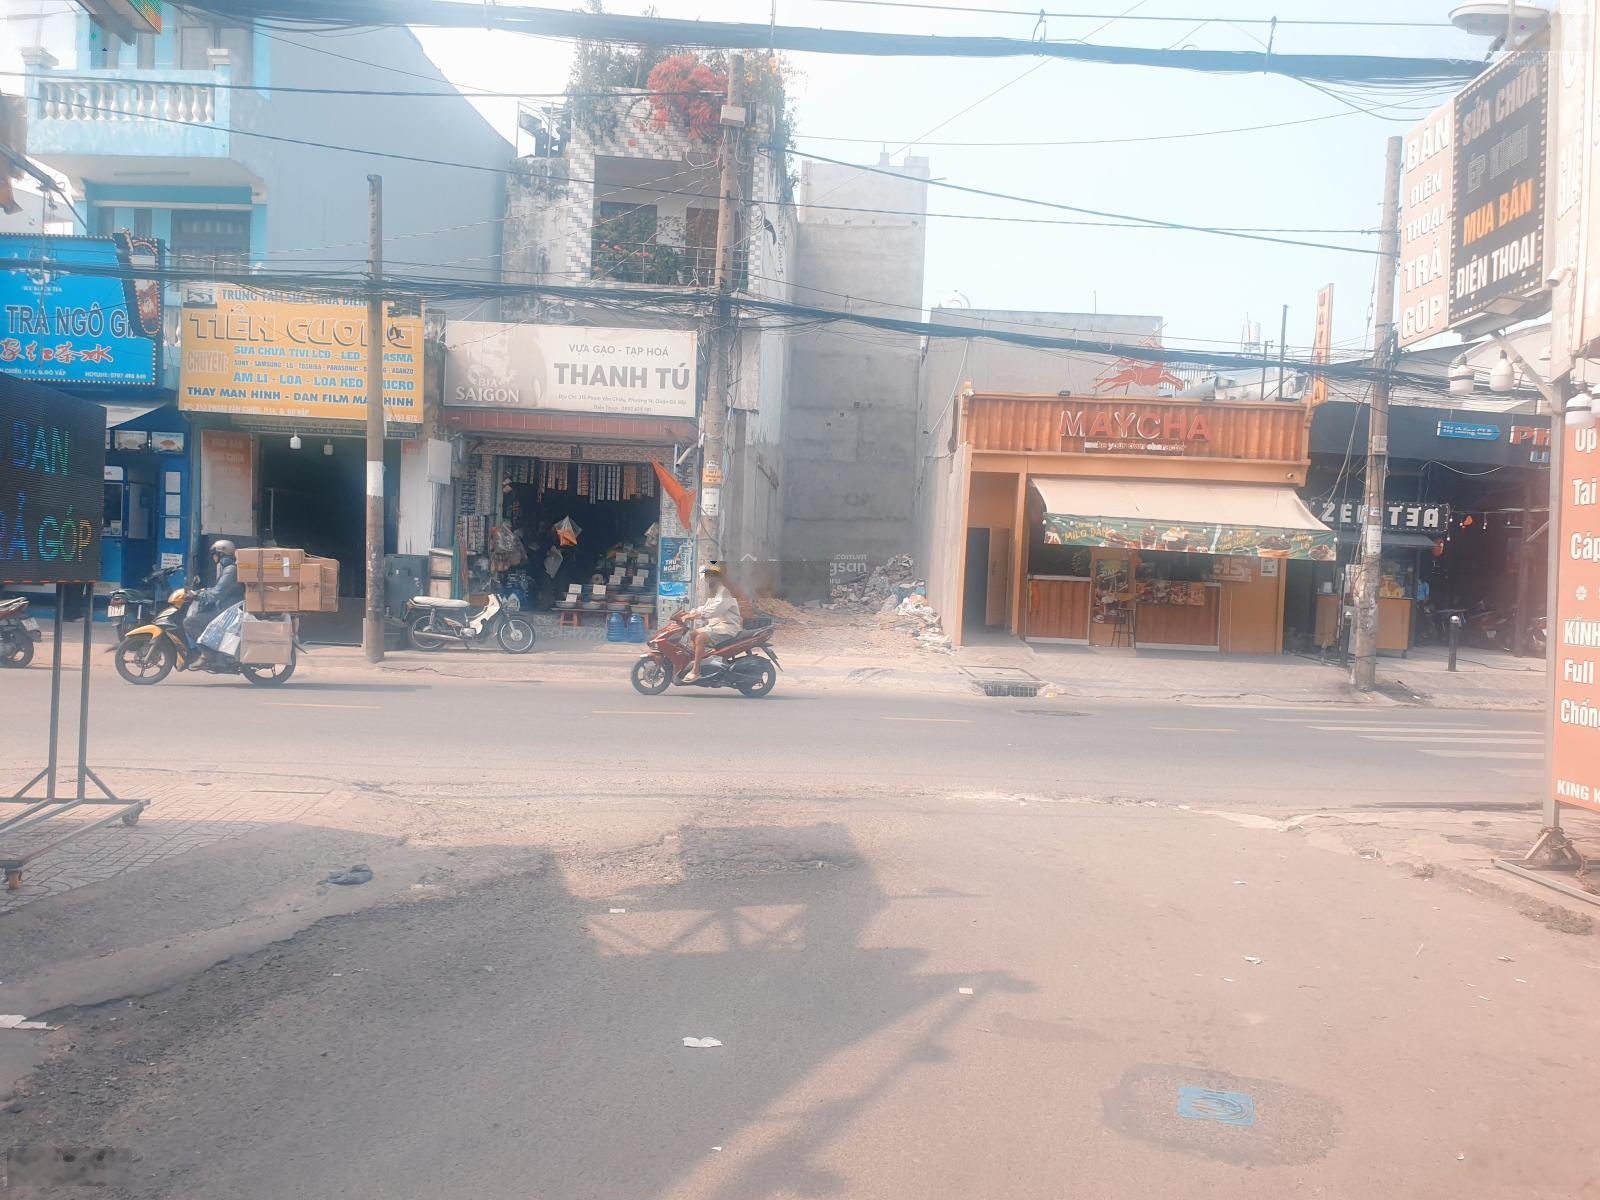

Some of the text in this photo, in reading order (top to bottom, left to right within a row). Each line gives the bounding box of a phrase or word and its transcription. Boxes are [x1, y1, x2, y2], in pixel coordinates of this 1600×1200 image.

[1406, 113, 1450, 174] BÁN
[1463, 201, 1495, 248] MUA
[1498, 177, 1535, 228] BÁN
[1456, 254, 1489, 299] ĐIỆN
[1492, 232, 1536, 282] THOẠI
[110, 309, 136, 338] GI
[1402, 293, 1443, 339] GÓP
[279, 375, 302, 385] LOA
[313, 377, 337, 387] LOA
[553, 362, 690, 390] THANH TÚ
[322, 394, 349, 403] FILM
[455, 386, 519, 403] SAIGON
[1060, 410, 1213, 440] MAYCHA
[1572, 478, 1597, 506] Tai
[1388, 506, 1439, 528] TEA
[38, 504, 92, 561] GÓP
[1564, 658, 1594, 685] Full
[1556, 779, 1590, 801] KING
